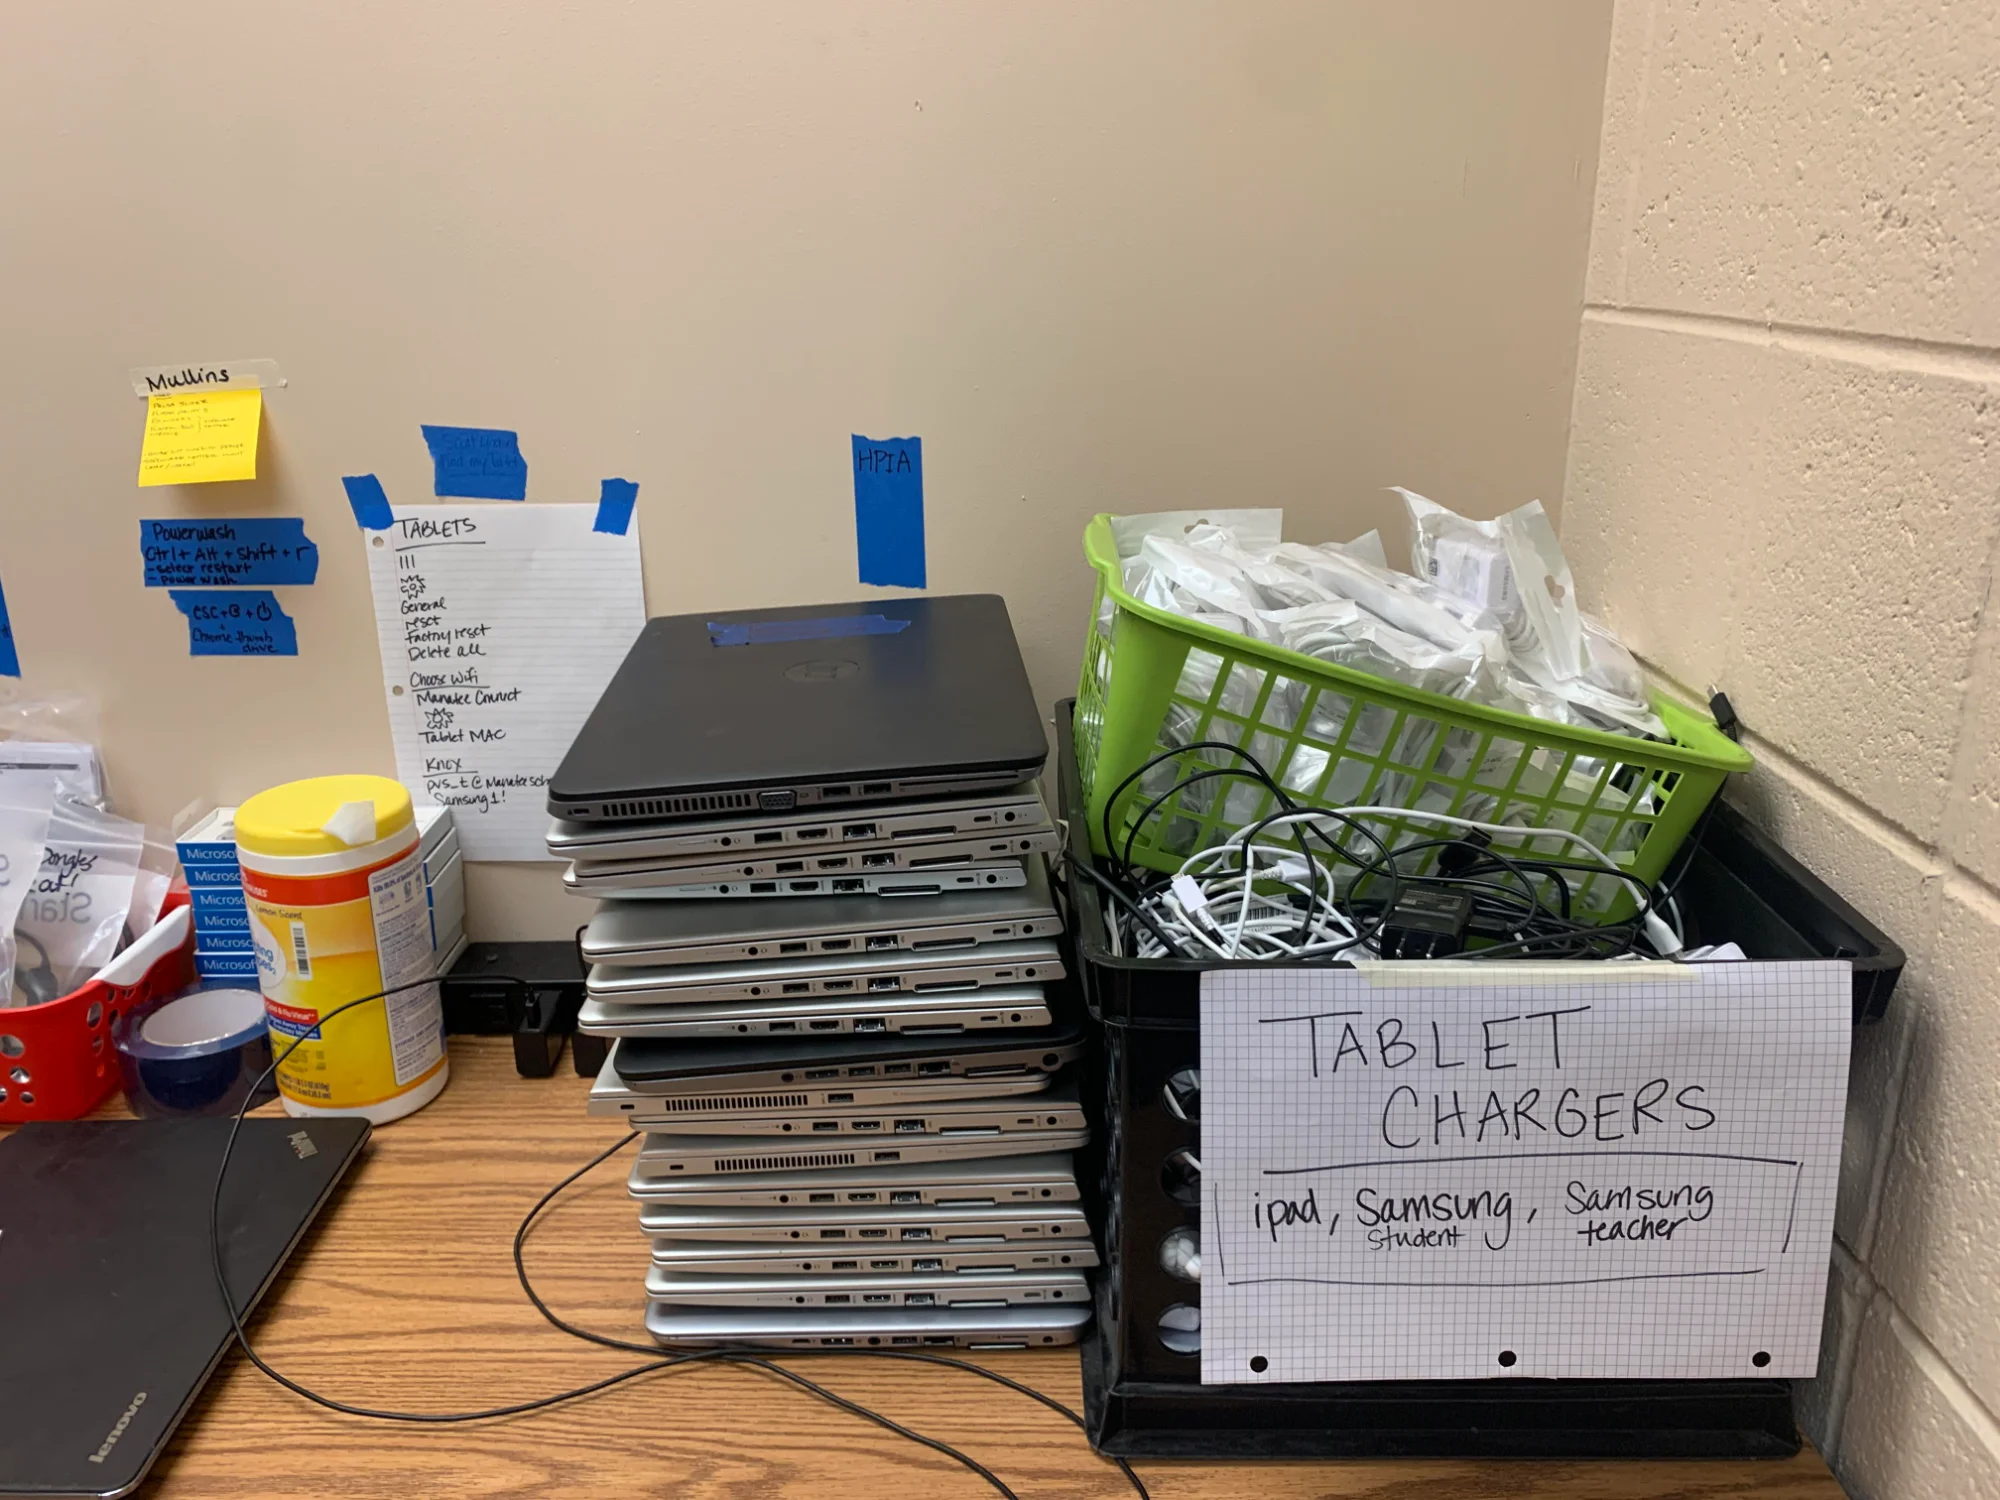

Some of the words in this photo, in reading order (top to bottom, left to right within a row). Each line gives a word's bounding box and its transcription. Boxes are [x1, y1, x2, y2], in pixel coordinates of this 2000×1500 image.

[146, 368, 230, 392] Mullins
[858, 447, 911, 474] HPIA
[152, 522, 236, 542] Powerwash
[395, 517, 477, 539] TABLETS
[236, 542, 277, 562] Shift
[201, 561, 252, 576] restart
[401, 597, 447, 615] General
[405, 615, 442, 630] reset
[455, 623, 492, 639] reset
[408, 645, 451, 661] Delete
[457, 643, 487, 658] all
[410, 671, 446, 688] Choose
[418, 729, 464, 744] Tablet
[469, 729, 506, 743] MAC
[426, 758, 462, 773] Knox
[1259, 1006, 1590, 1077] TABLET
[1381, 1078, 1716, 1149] CHARGERS
[1253, 1188, 1339, 1242] ipad,
[1356, 1188, 1538, 1250] Samsung,
[1565, 1180, 1714, 1221] Samsung
[1367, 1225, 1466, 1251] student
[1577, 1215, 1689, 1246] teacher
[88, 1392, 147, 1464] lenovo
